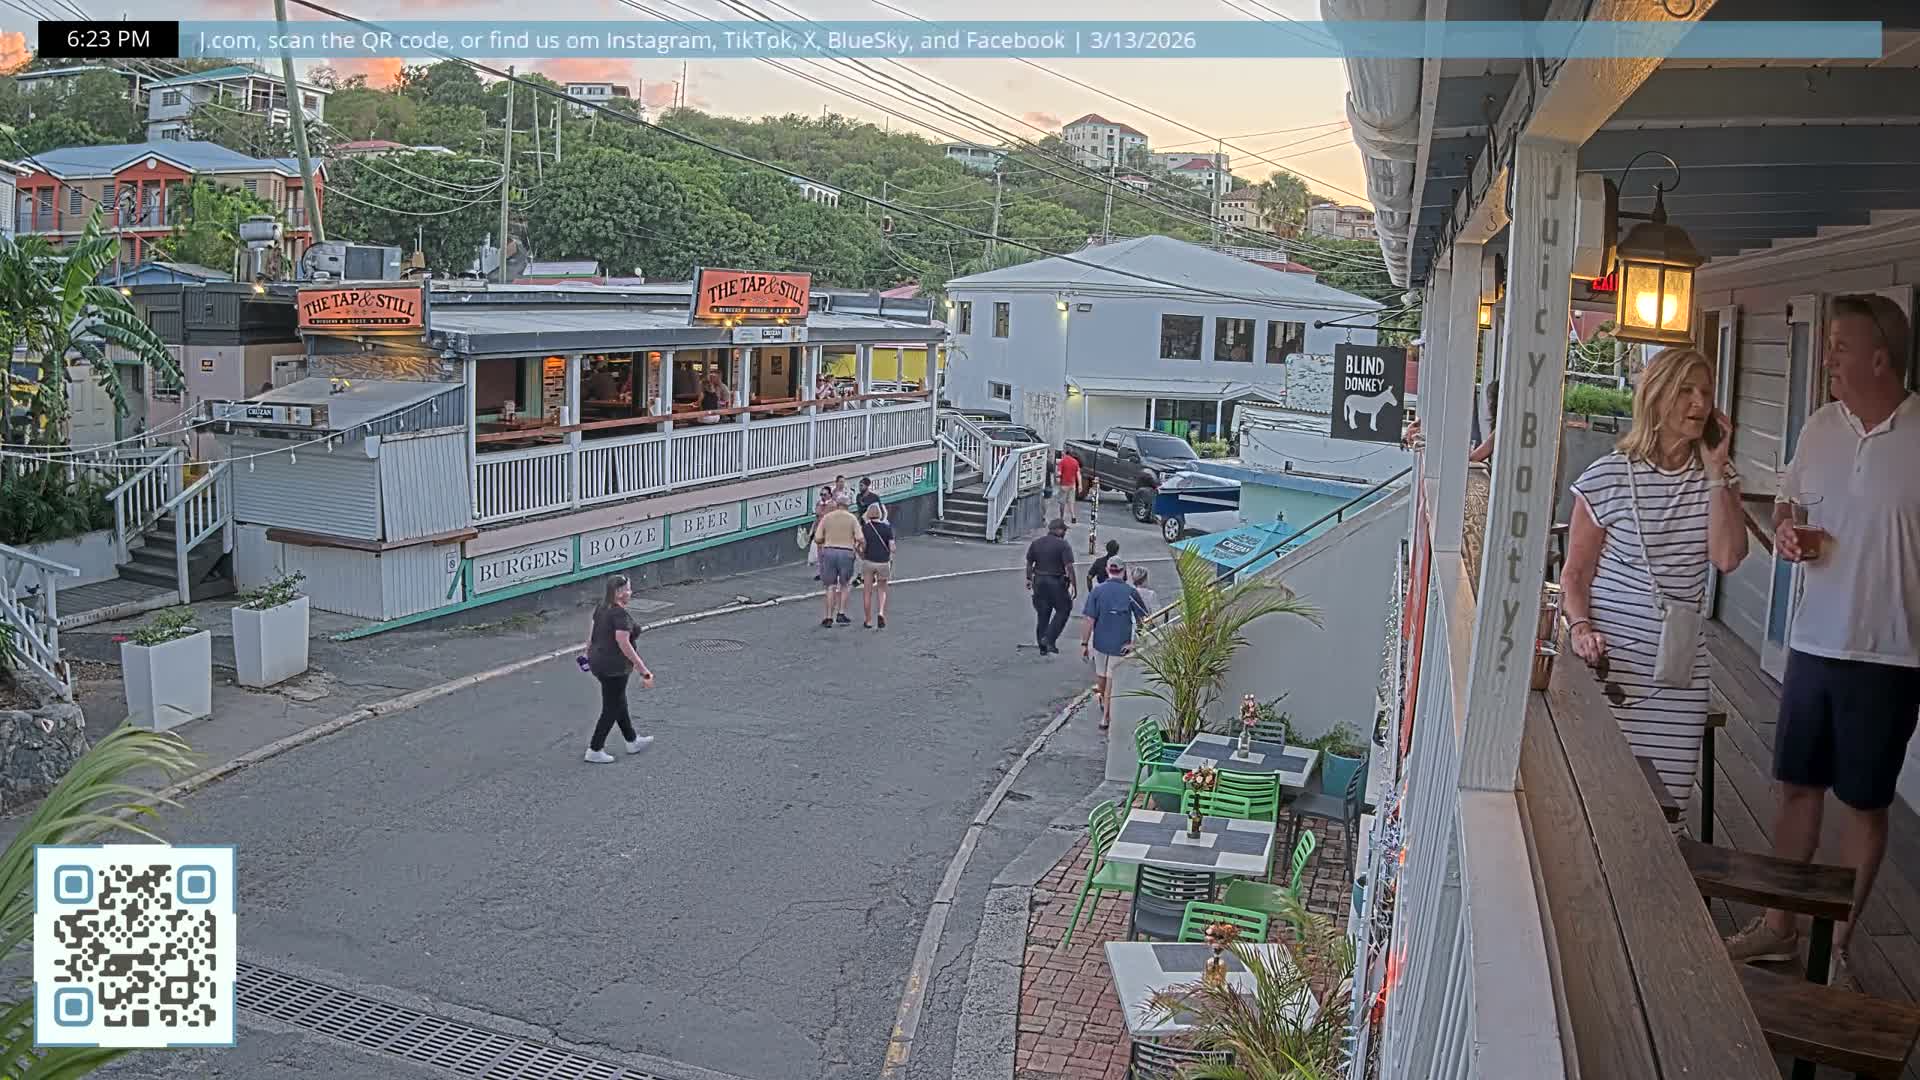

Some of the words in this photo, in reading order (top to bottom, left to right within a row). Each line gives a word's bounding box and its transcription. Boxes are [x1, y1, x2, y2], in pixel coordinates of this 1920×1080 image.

[708, 279, 738, 303] THE
[740, 276, 767, 293] TAP
[764, 275, 779, 294] &
[778, 280, 805, 306] STILL
[304, 297, 330, 317] THE
[331, 292, 359, 307] TAP
[358, 291, 375, 308] &
[376, 293, 415, 317] STILL
[1345, 354, 1385, 375] BLIND
[1344, 376, 1385, 392] DONKEY
[248, 408, 272, 416] CRUZAN
[753, 497, 802, 518] WINGS
[683, 511, 728, 533] BEER
[589, 527, 656, 556] BOOZE
[479, 548, 568, 582] BURGERS
